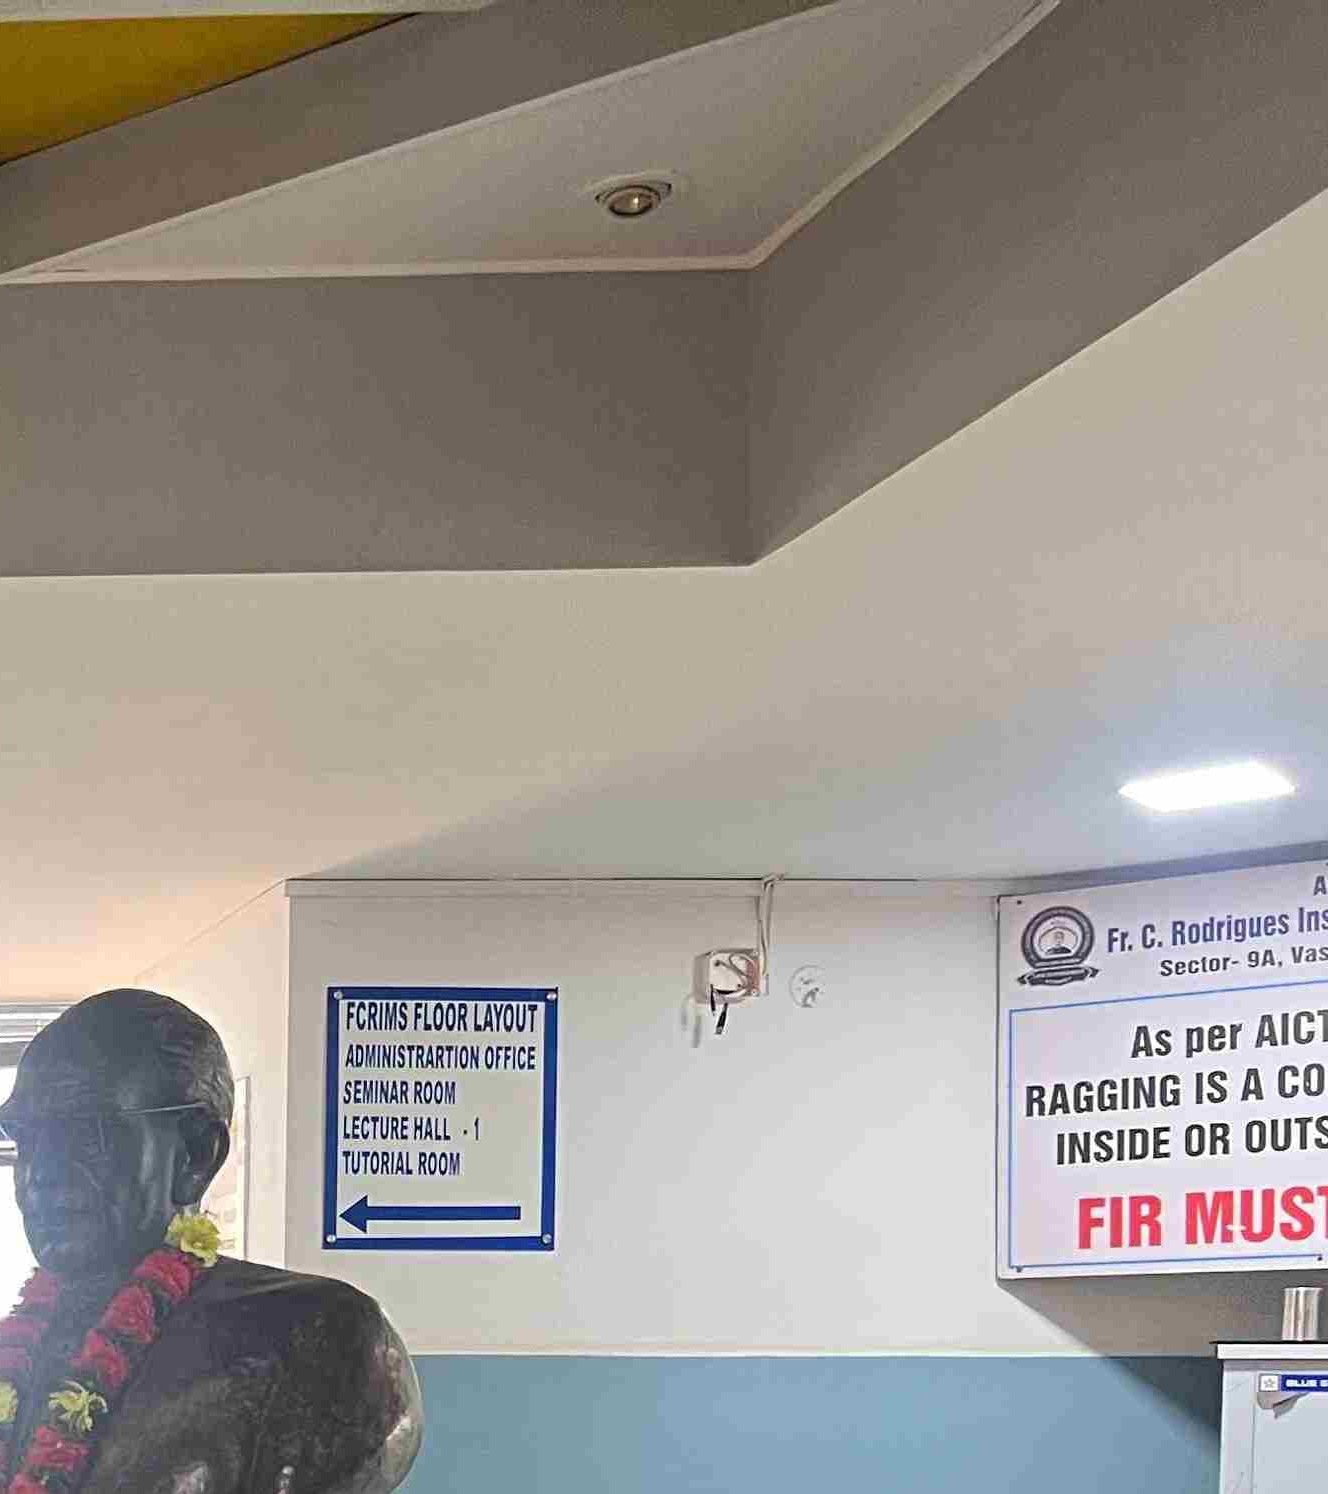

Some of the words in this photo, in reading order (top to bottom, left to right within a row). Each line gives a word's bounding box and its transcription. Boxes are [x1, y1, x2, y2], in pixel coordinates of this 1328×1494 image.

[1107, 927, 1133, 953] Fr.
[1141, 923, 1163, 949] C.
[1171, 912, 1290, 946] Rodrigues
[1160, 956, 1240, 977] Sector-
[1247, 949, 1284, 969] 9A,
[345, 1001, 408, 1031] FCRIMS
[413, 1002, 468, 1032] FLOOR
[473, 1003, 538, 1033] LAYOUT
[1130, 1024, 1172, 1058] As
[1185, 1022, 1243, 1059] per
[345, 1044, 480, 1070] ADMINISTRARTION
[484, 1045, 536, 1070] OFFICE
[342, 1080, 409, 1105] SEMINAR
[413, 1081, 456, 1105] ROOM
[1025, 1073, 1181, 1117] RAGGING
[1195, 1069, 1228, 1105] IS
[1240, 1067, 1265, 1101] A
[1277, 1062, 1325, 1099] CO
[342, 1115, 409, 1141] LECTURE
[413, 1117, 451, 1141] HALL
[473, 1116, 481, 1141] 1
[1056, 1126, 1171, 1165] INSIDE
[1184, 1122, 1230, 1157] OR
[342, 1151, 413, 1176] TUTORIAL
[417, 1152, 461, 1176] ROOM
[1077, 1194, 1163, 1250] FIR
